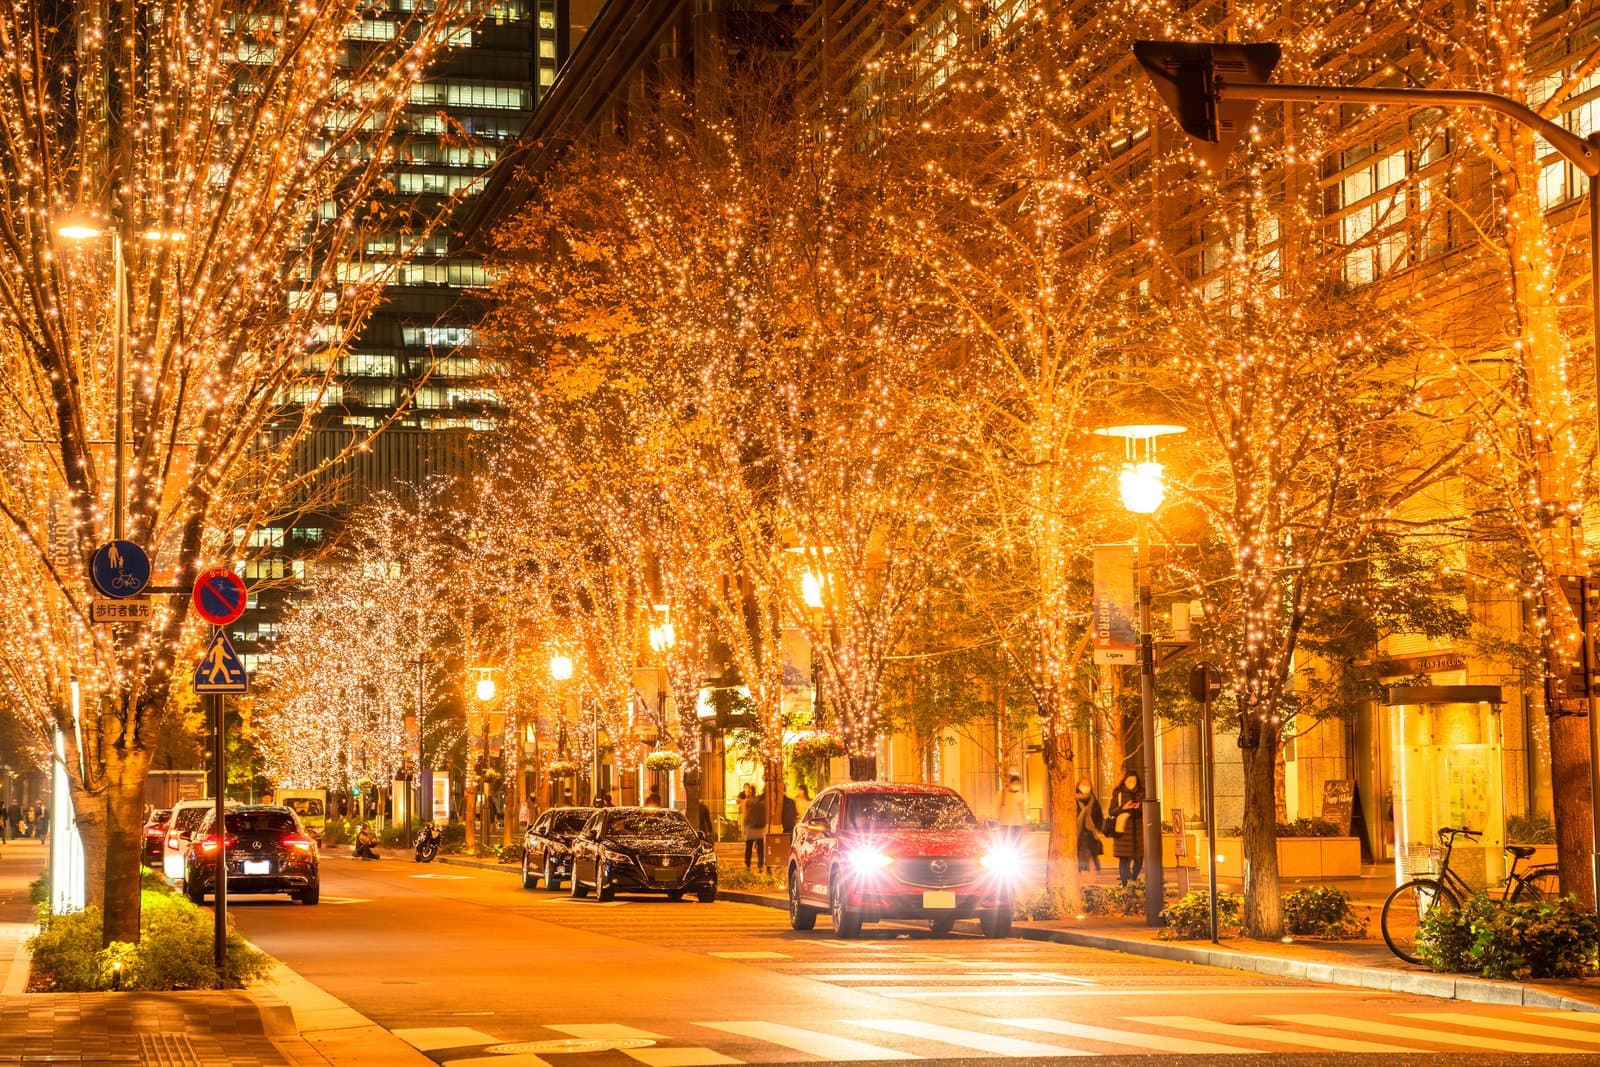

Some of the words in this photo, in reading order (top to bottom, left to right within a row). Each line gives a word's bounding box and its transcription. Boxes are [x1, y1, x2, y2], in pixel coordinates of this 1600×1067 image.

[96, 604, 150, 617] 歩行者優先
